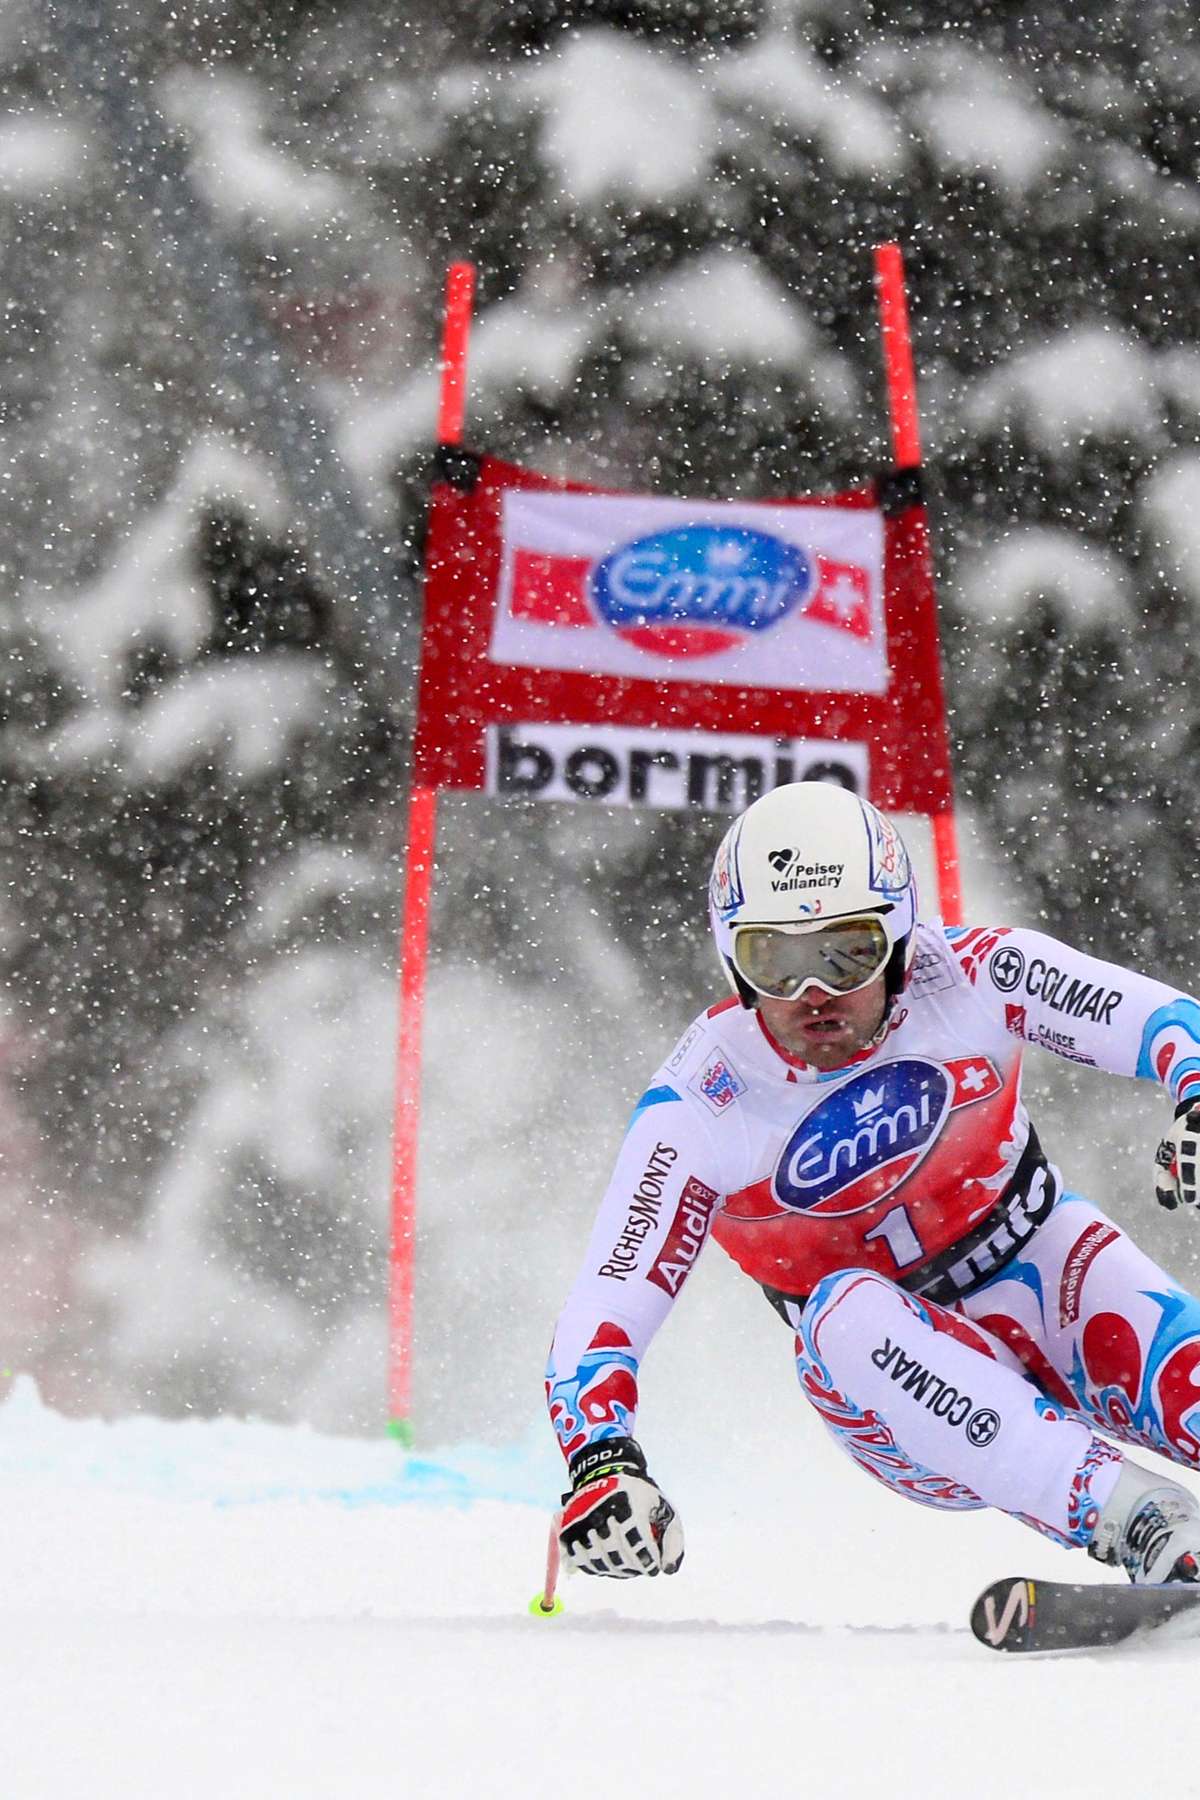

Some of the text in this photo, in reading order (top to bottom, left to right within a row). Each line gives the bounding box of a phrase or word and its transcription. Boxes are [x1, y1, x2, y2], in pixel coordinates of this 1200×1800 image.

[607, 549, 795, 614] Emmi
[771, 874, 842, 892] Vallandry
[796, 863, 844, 877] Peisey
[1025, 959, 1123, 1026] COLMAR
[1038, 1024, 1076, 1051] CAISSE
[788, 1080, 930, 1188] Emmi
[598, 1142, 678, 1281] RICHESMONTS
[657, 1194, 709, 1293] Audi
[864, 1202, 925, 1269] 1
[871, 1338, 973, 1426] COLMAR
